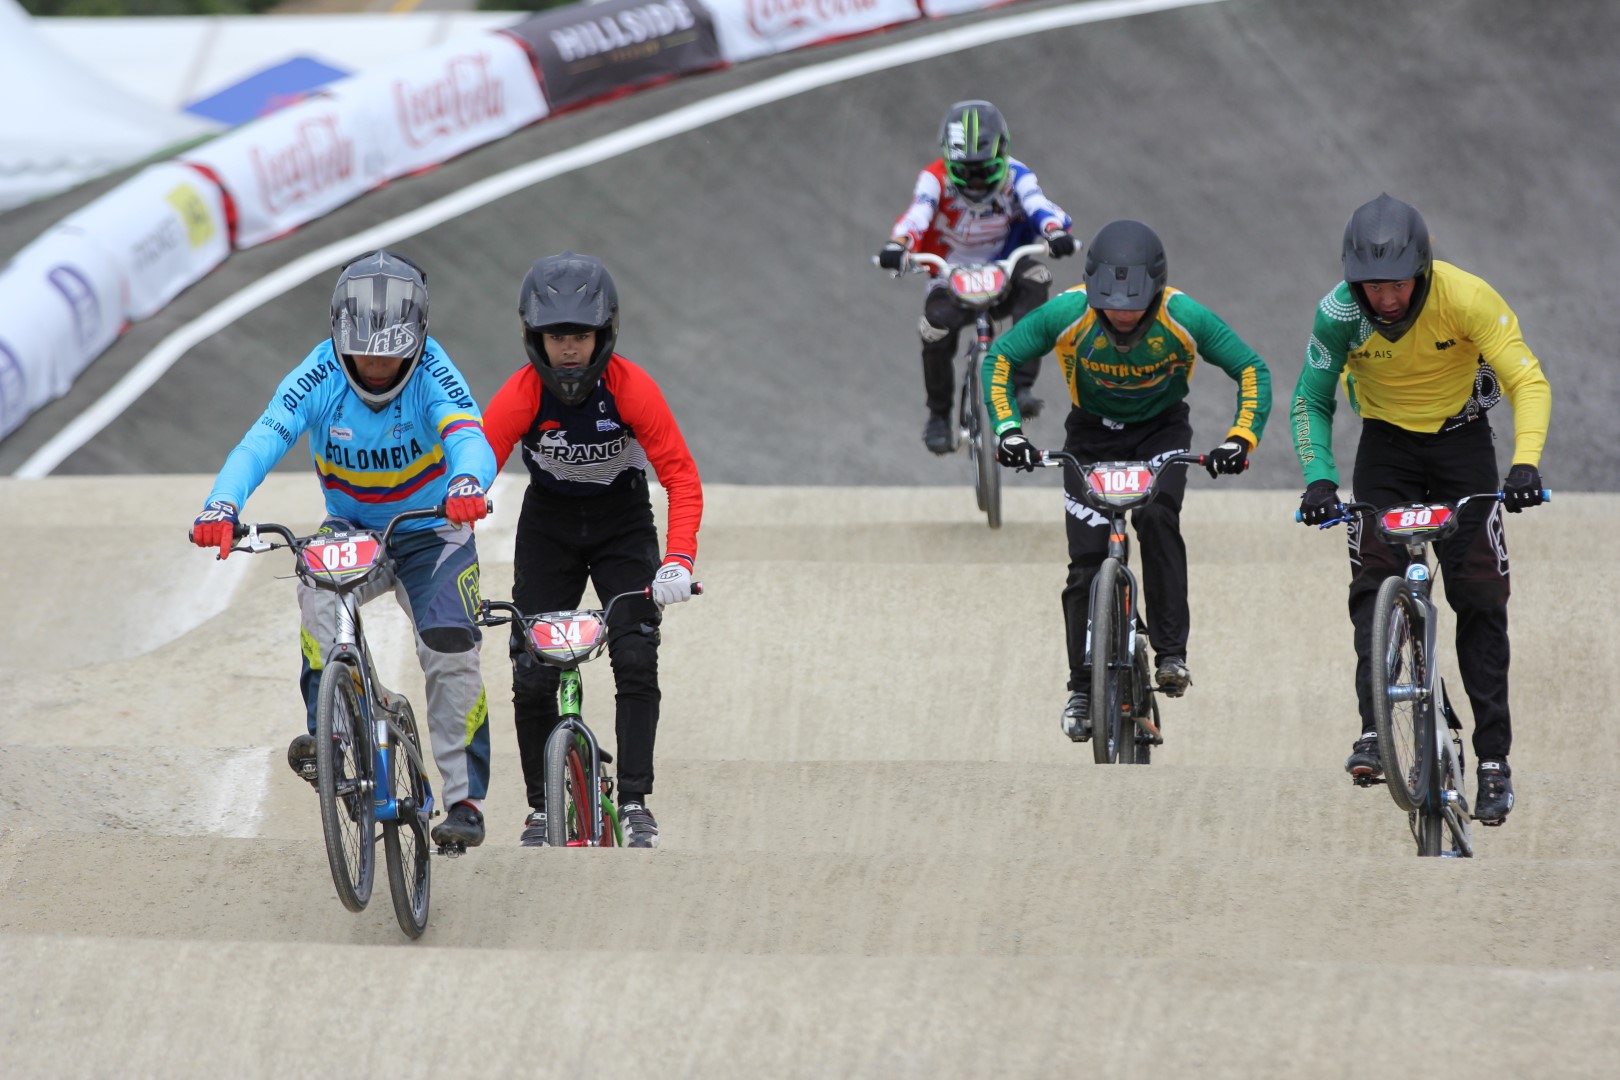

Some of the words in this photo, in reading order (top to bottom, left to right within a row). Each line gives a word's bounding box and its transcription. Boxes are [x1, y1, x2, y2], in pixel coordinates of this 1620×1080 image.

[549, 0, 696, 62] HILLSIDE
[1374, 350, 1393, 359] AIS
[1081, 357, 1130, 378] SOUTH
[421, 351, 473, 409] OLOMBIA
[325, 437, 423, 470] COLOMBIA
[449, 484, 484, 497] FOX
[1101, 471, 1140, 491] 104
[1400, 510, 1432, 527] 80
[322, 542, 358, 570] 03
[550, 621, 582, 646] 94
